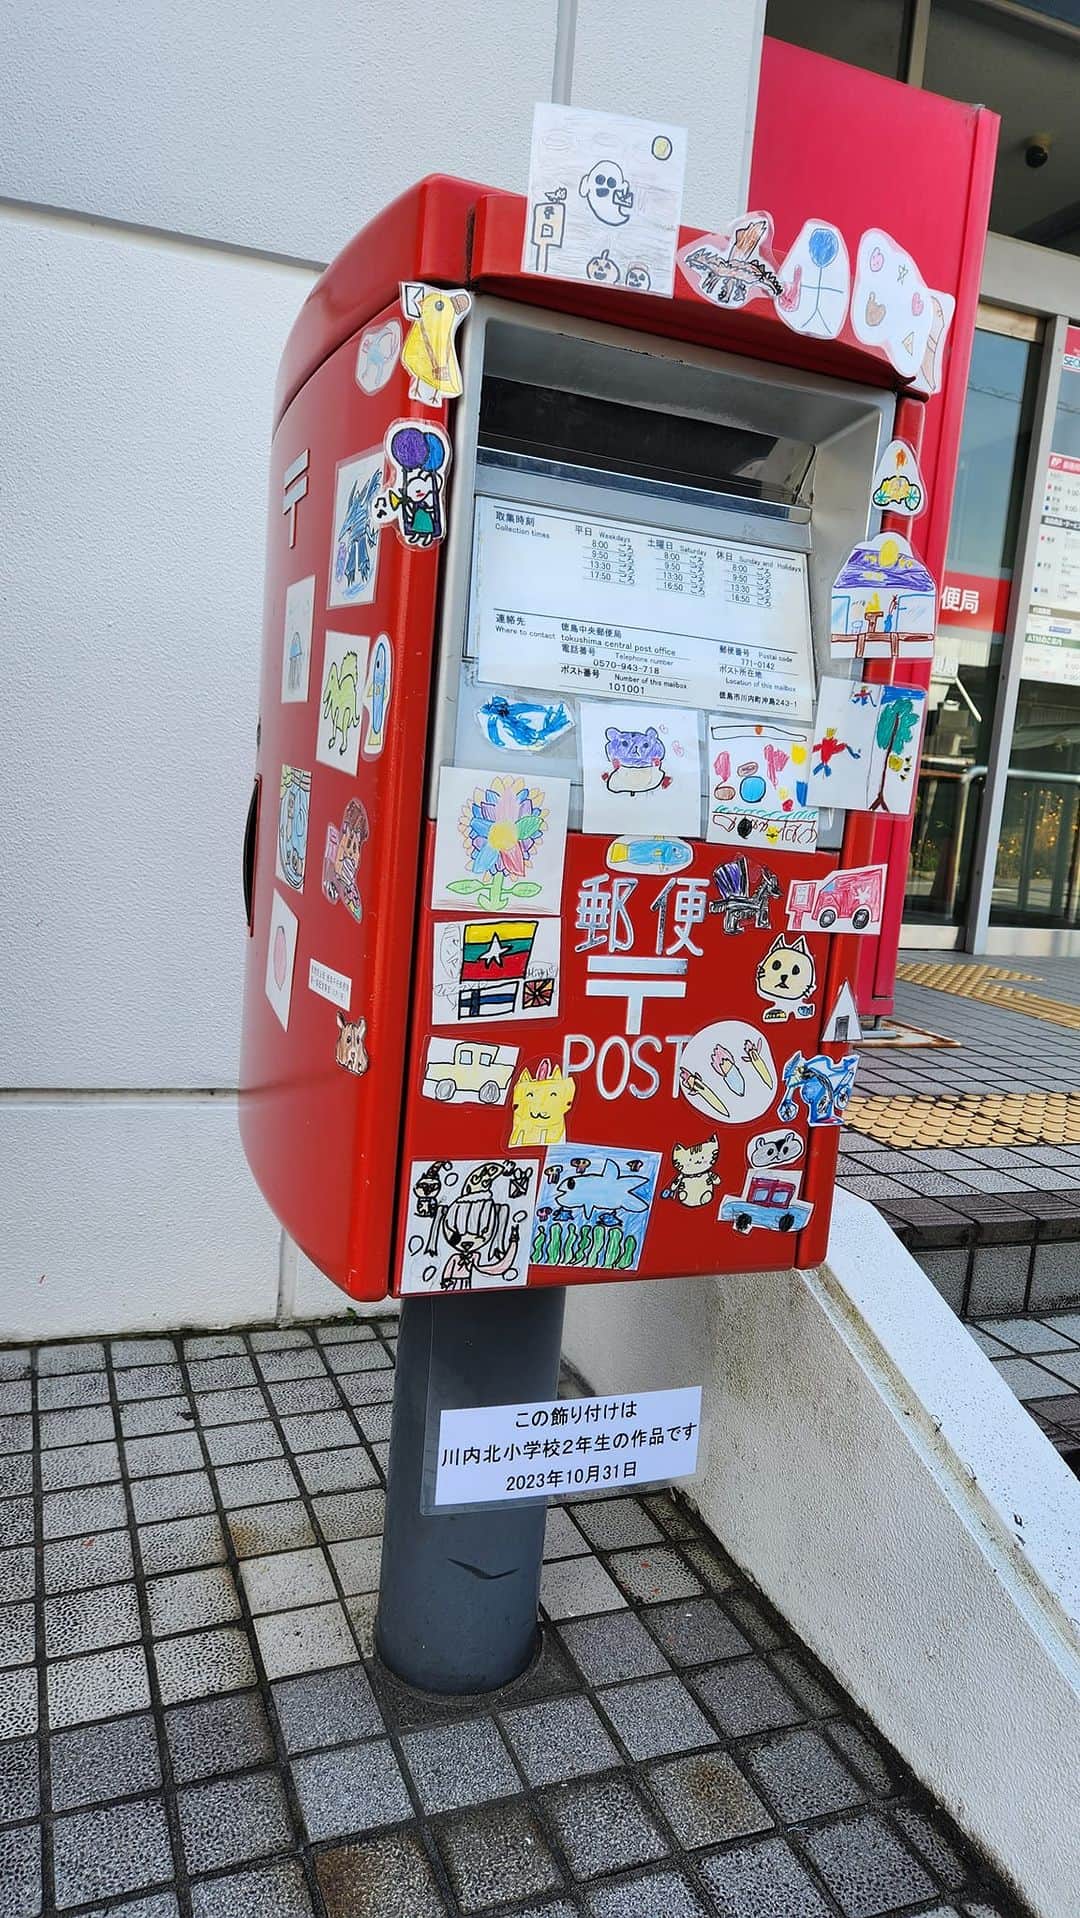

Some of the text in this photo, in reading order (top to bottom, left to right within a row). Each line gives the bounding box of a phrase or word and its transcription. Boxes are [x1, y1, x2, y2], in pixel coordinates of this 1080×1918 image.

[495, 511, 535, 527] 取集時刻
[495, 524, 550, 539] Collection times
[575, 525, 631, 542] 平日 Weekdays
[592, 540, 633, 554] 8:00 ごろ
[648, 539, 706, 557] 土曜日 Saturday
[592, 550, 634, 564] 9:50 ごろ
[664, 552, 704, 565] 8:00 ごろ
[716, 551, 733, 561] 休日
[739, 556, 761, 566] Sunday
[762, 560, 773, 568] and
[590, 560, 635, 575] 13:30 ごろ
[665, 562, 704, 576] 9:50 ごろ
[732, 563, 771, 578] 8:00 ごろ
[590, 571, 635, 585] 17:50 ごろ
[663, 572, 705, 585] 13:30 ごろ
[733, 574, 771, 588] 9:50 ごろ
[664, 582, 705, 596] 16:50 ごろ
[731, 584, 771, 598] 13:30 ごろ
[731, 594, 771, 607] 16:50 ごろ
[941, 585, 980, 615] 便局
[496, 614, 526, 626] 連絡先
[495, 625, 517, 635] Where
[529, 630, 556, 639] contact
[561, 623, 622, 639] 徳島中央郵便局
[561, 635, 676, 656] tokushima central post office
[720, 645, 749, 657] 郵便番号
[759, 652, 777, 660] Postal
[562, 644, 673, 666] 電話番号 Telephone number
[593, 659, 660, 675] 0570-943-718
[720, 664, 762, 678] ポスト所在地
[741, 659, 774, 670] 771-0142
[561, 665, 687, 689] ポスト番号 Number of this mailbox
[609, 683, 645, 694] 101001
[726, 678, 752, 686] Location
[761, 682, 772, 690] this
[774, 684, 796, 692] mailbox
[574, 873, 710, 957] 郵便
[562, 1034, 693, 1101] POST
[514, 1400, 638, 1428] この飾り付けは
[441, 1421, 698, 1467] 川内北小学校2年生の作品です
[506, 1461, 638, 1491] 2023年10月31日
